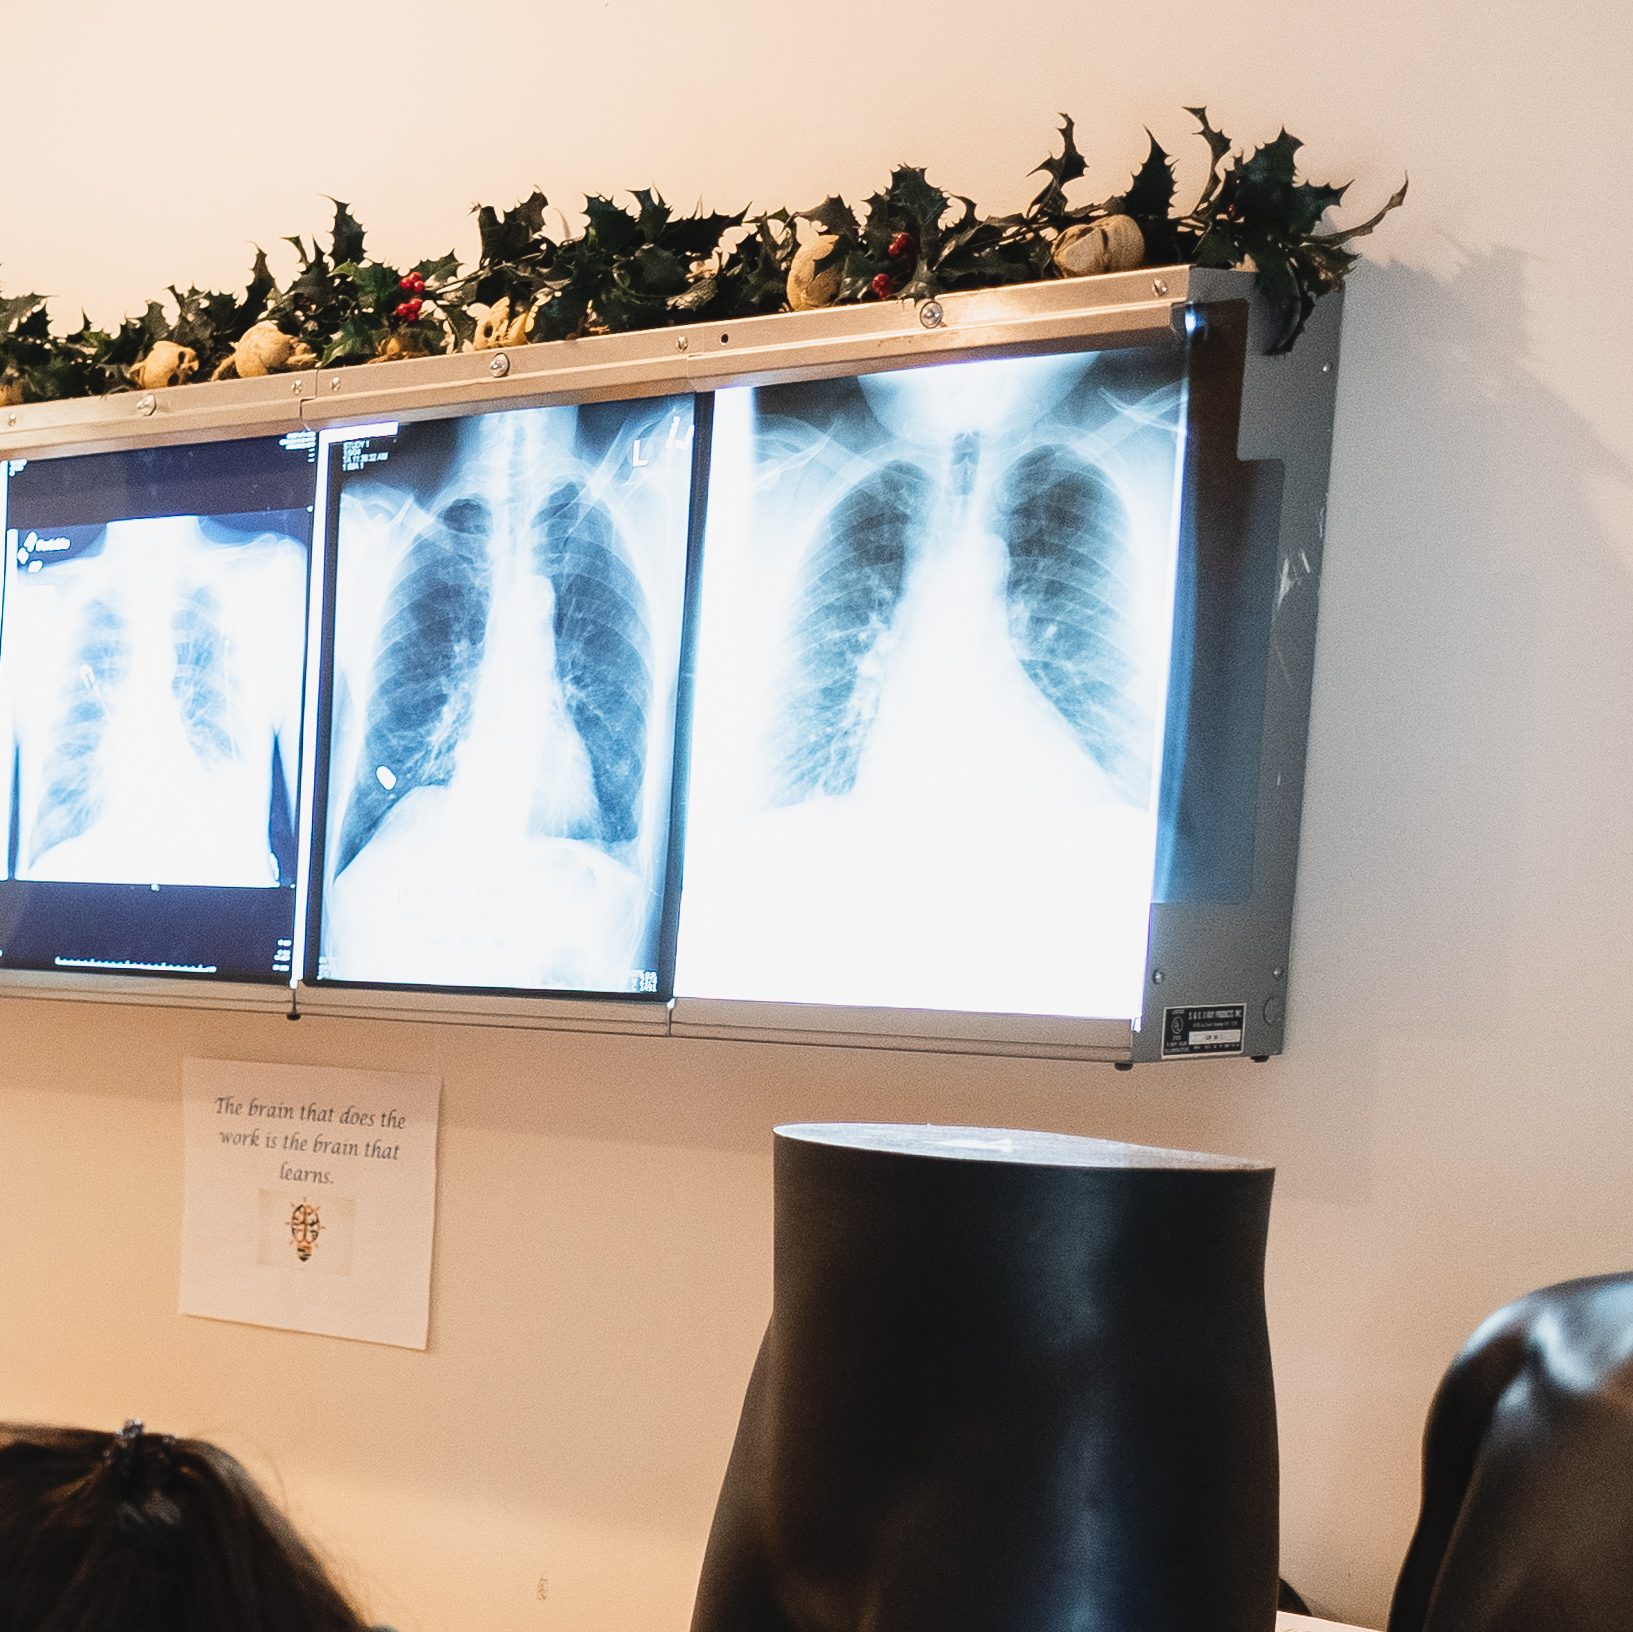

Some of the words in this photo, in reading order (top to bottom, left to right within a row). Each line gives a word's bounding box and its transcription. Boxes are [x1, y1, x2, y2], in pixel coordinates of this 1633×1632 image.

[632, 440, 648, 467] L
[216, 1096, 243, 1116] The
[247, 1098, 294, 1119] brain
[300, 1102, 334, 1123] that
[339, 1106, 376, 1127] does
[381, 1109, 406, 1129] the
[219, 1128, 260, 1147] work
[266, 1131, 277, 1149] is
[283, 1131, 308, 1151] the
[313, 1133, 358, 1156] brain
[364, 1139, 400, 1161] that
[280, 1161, 334, 1185] learns.
